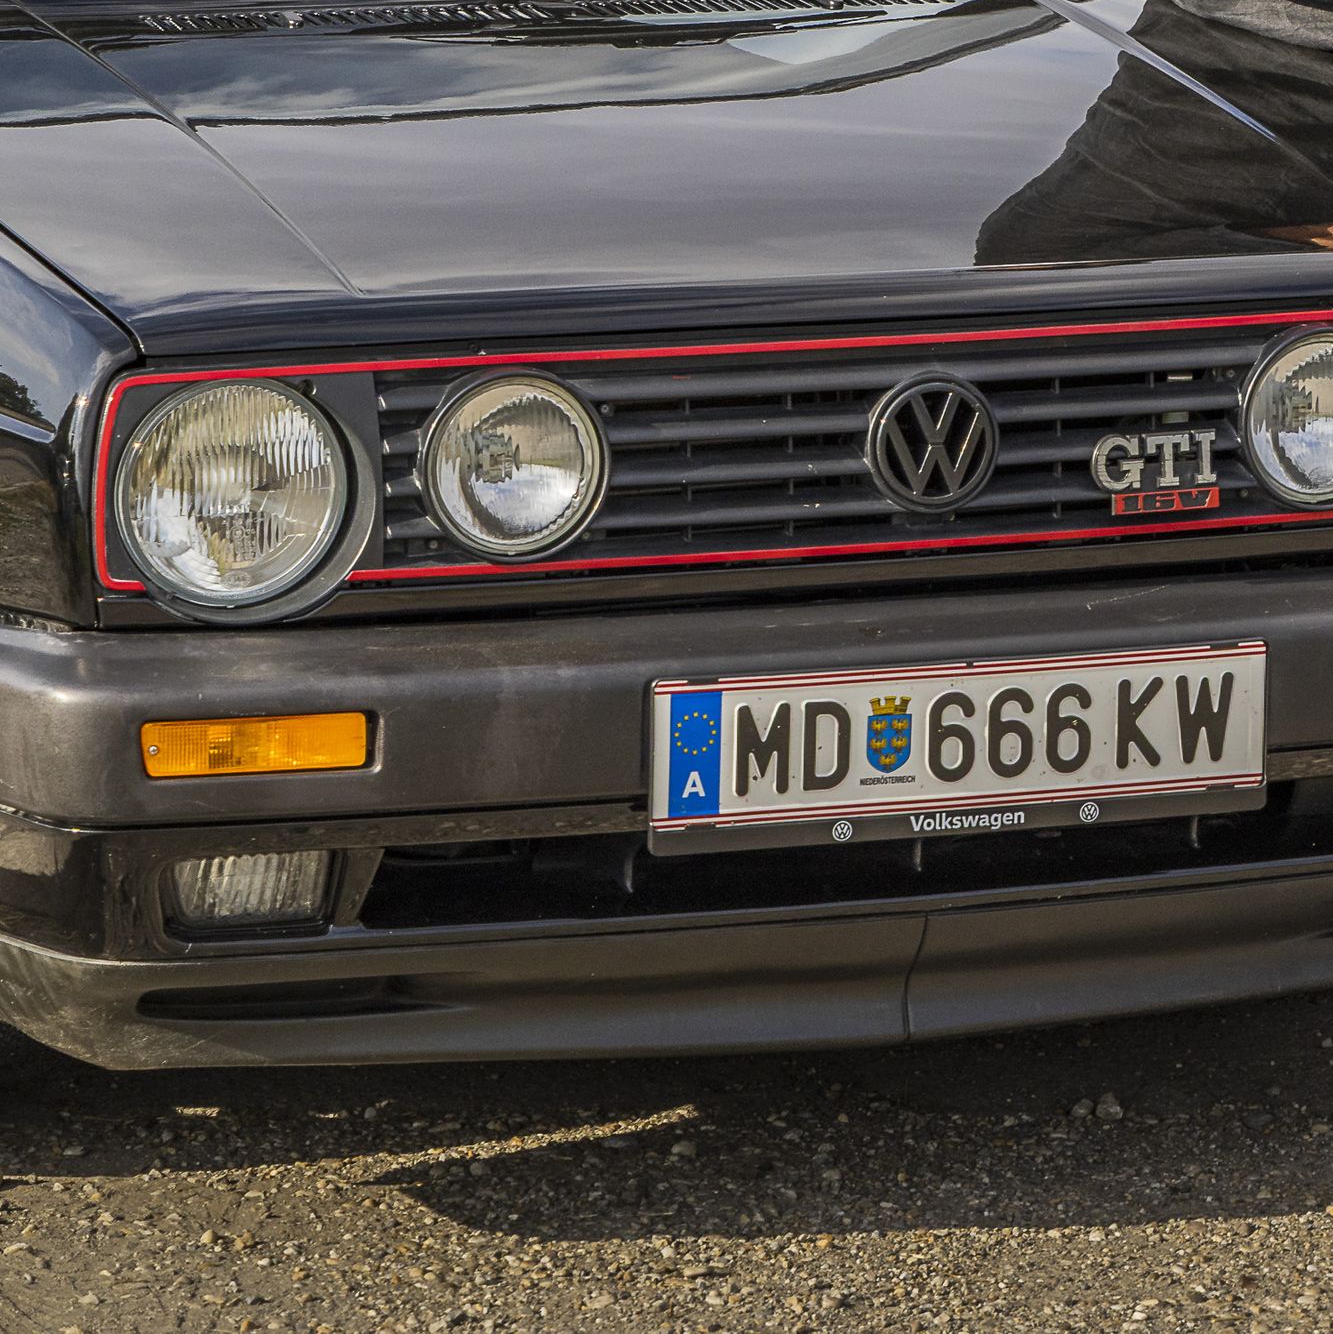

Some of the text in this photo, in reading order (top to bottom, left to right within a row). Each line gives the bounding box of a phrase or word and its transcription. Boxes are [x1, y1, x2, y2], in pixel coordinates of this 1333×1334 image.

[1091, 429, 1217, 491] GTI
[1119, 488, 1215, 514] 16V
[734, 671, 1234, 797] MD 666 KW
[681, 771, 706, 799] A
[859, 774, 916, 786] NIEDERÖSTERREICH
[909, 808, 1026, 834] Volkswagen
